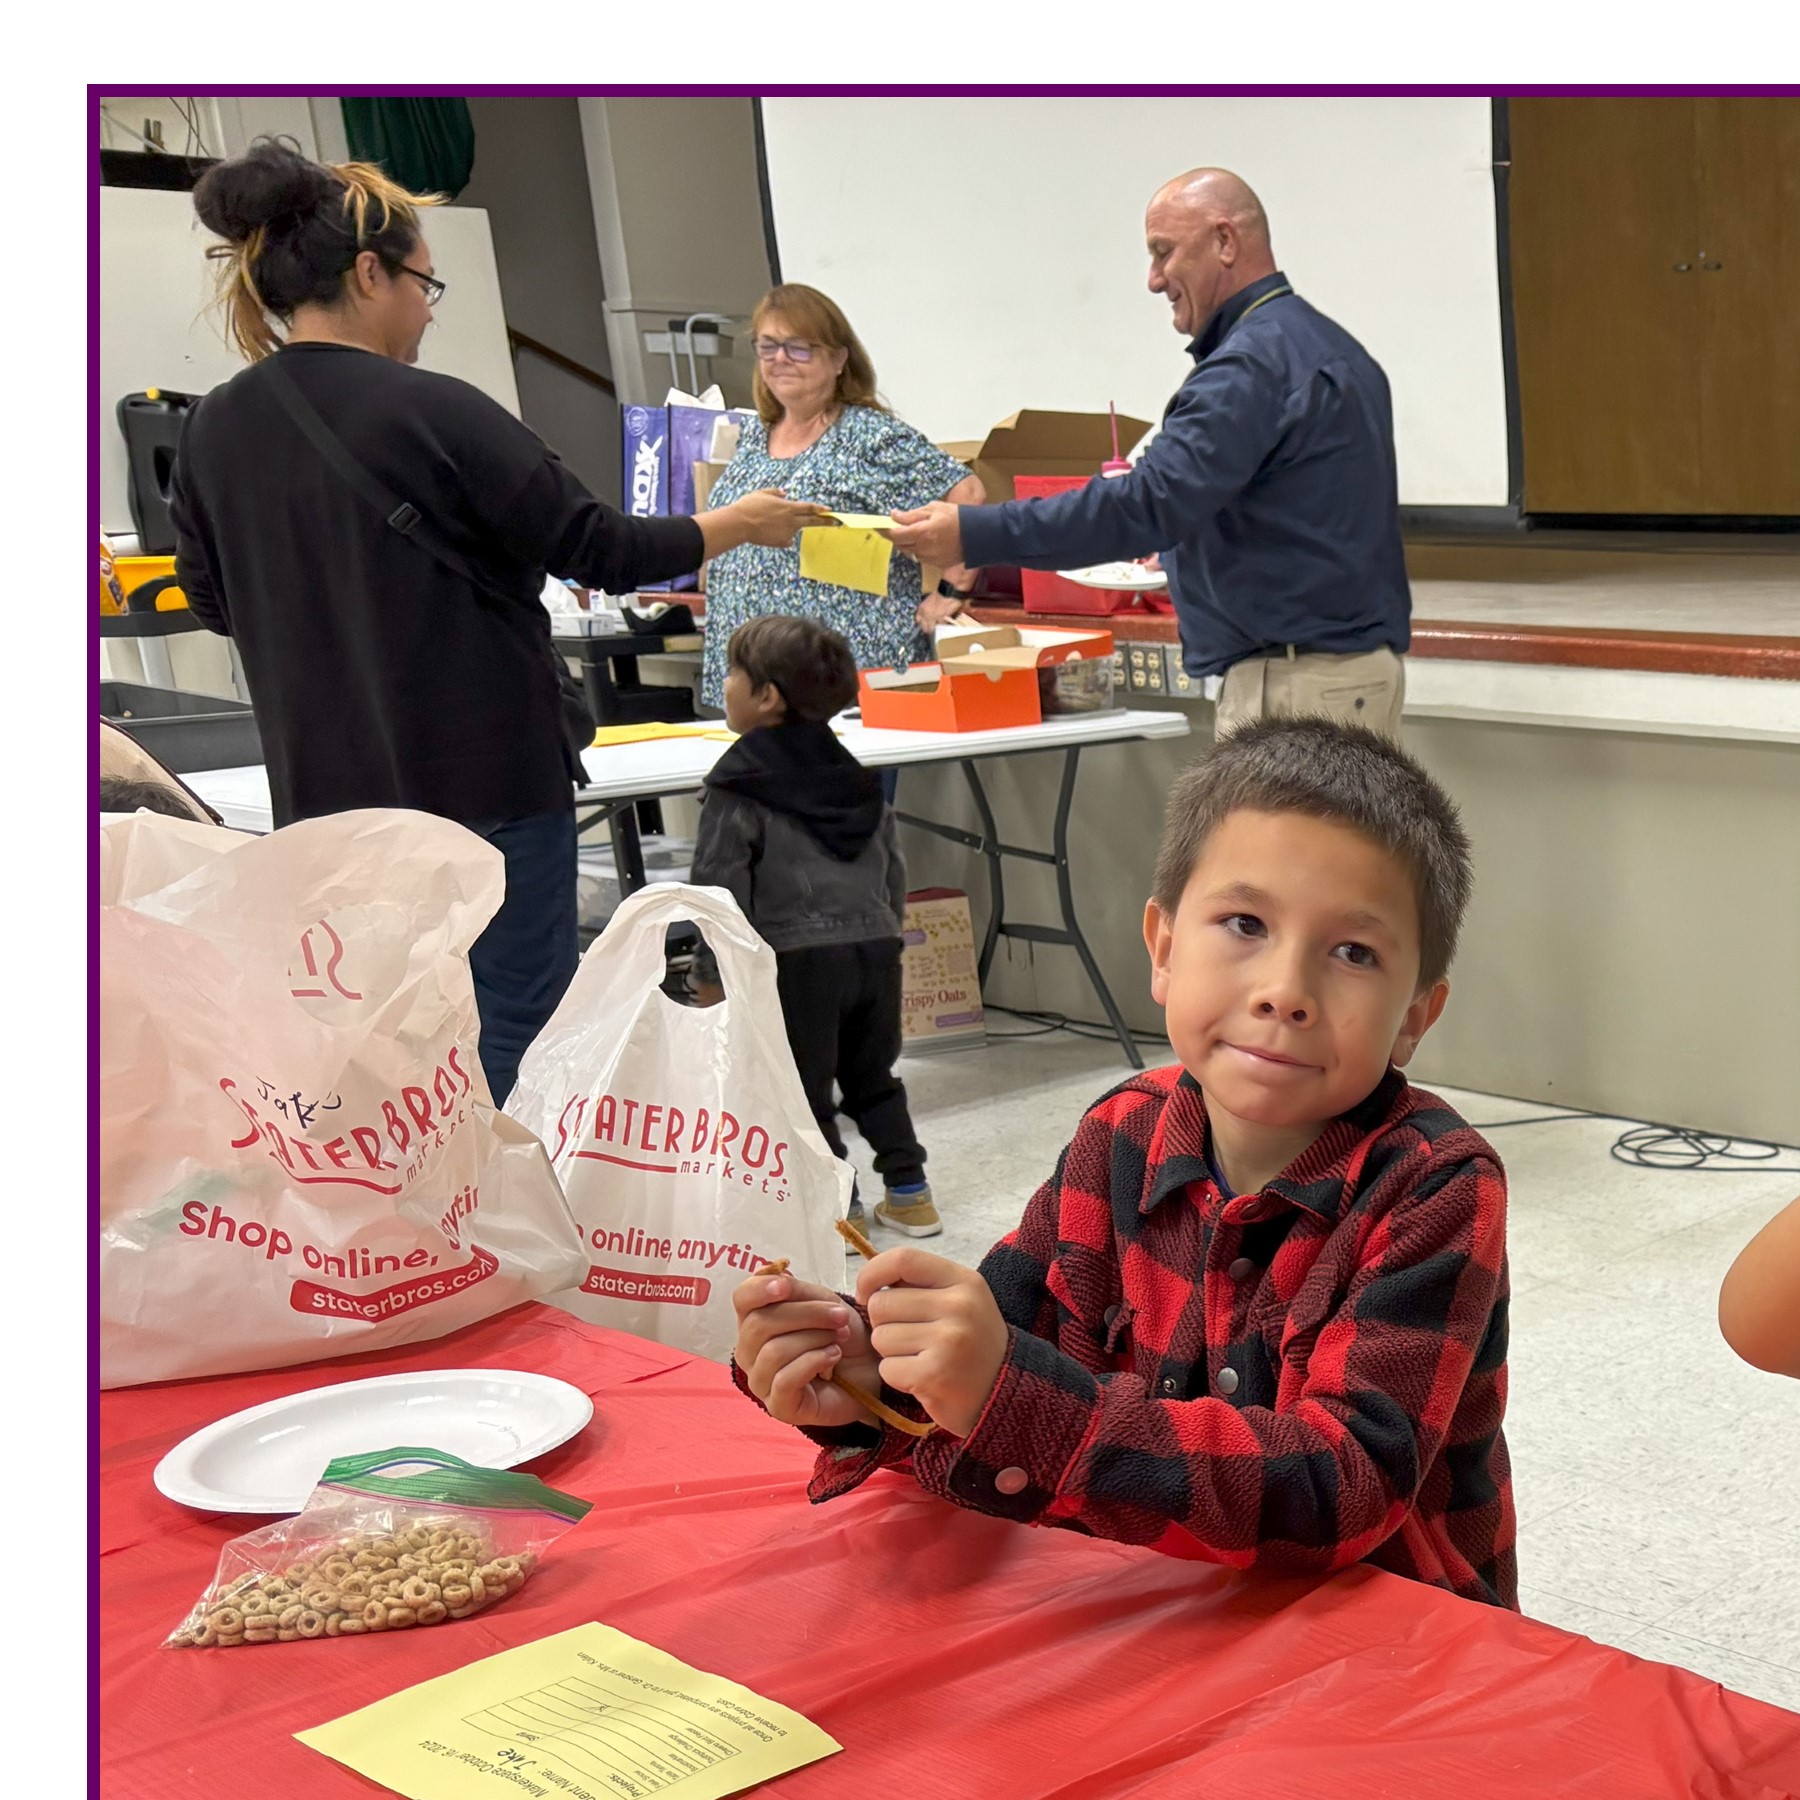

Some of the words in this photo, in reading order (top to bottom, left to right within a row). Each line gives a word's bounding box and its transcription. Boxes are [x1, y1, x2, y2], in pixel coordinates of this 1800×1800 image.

[902, 994, 937, 1009] rispy
[680, 1159, 786, 1202] markets
[179, 1200, 293, 1261] Shop
[302, 1244, 439, 1279] online,
[591, 1226, 673, 1262] online,
[590, 1273, 696, 1300] staterbros.com
[455, 1753, 494, 1773] October
[491, 1768, 549, 1798] Makerspace
[538, 1768, 573, 1789] Name:
[606, 1773, 644, 1798] Projects:
